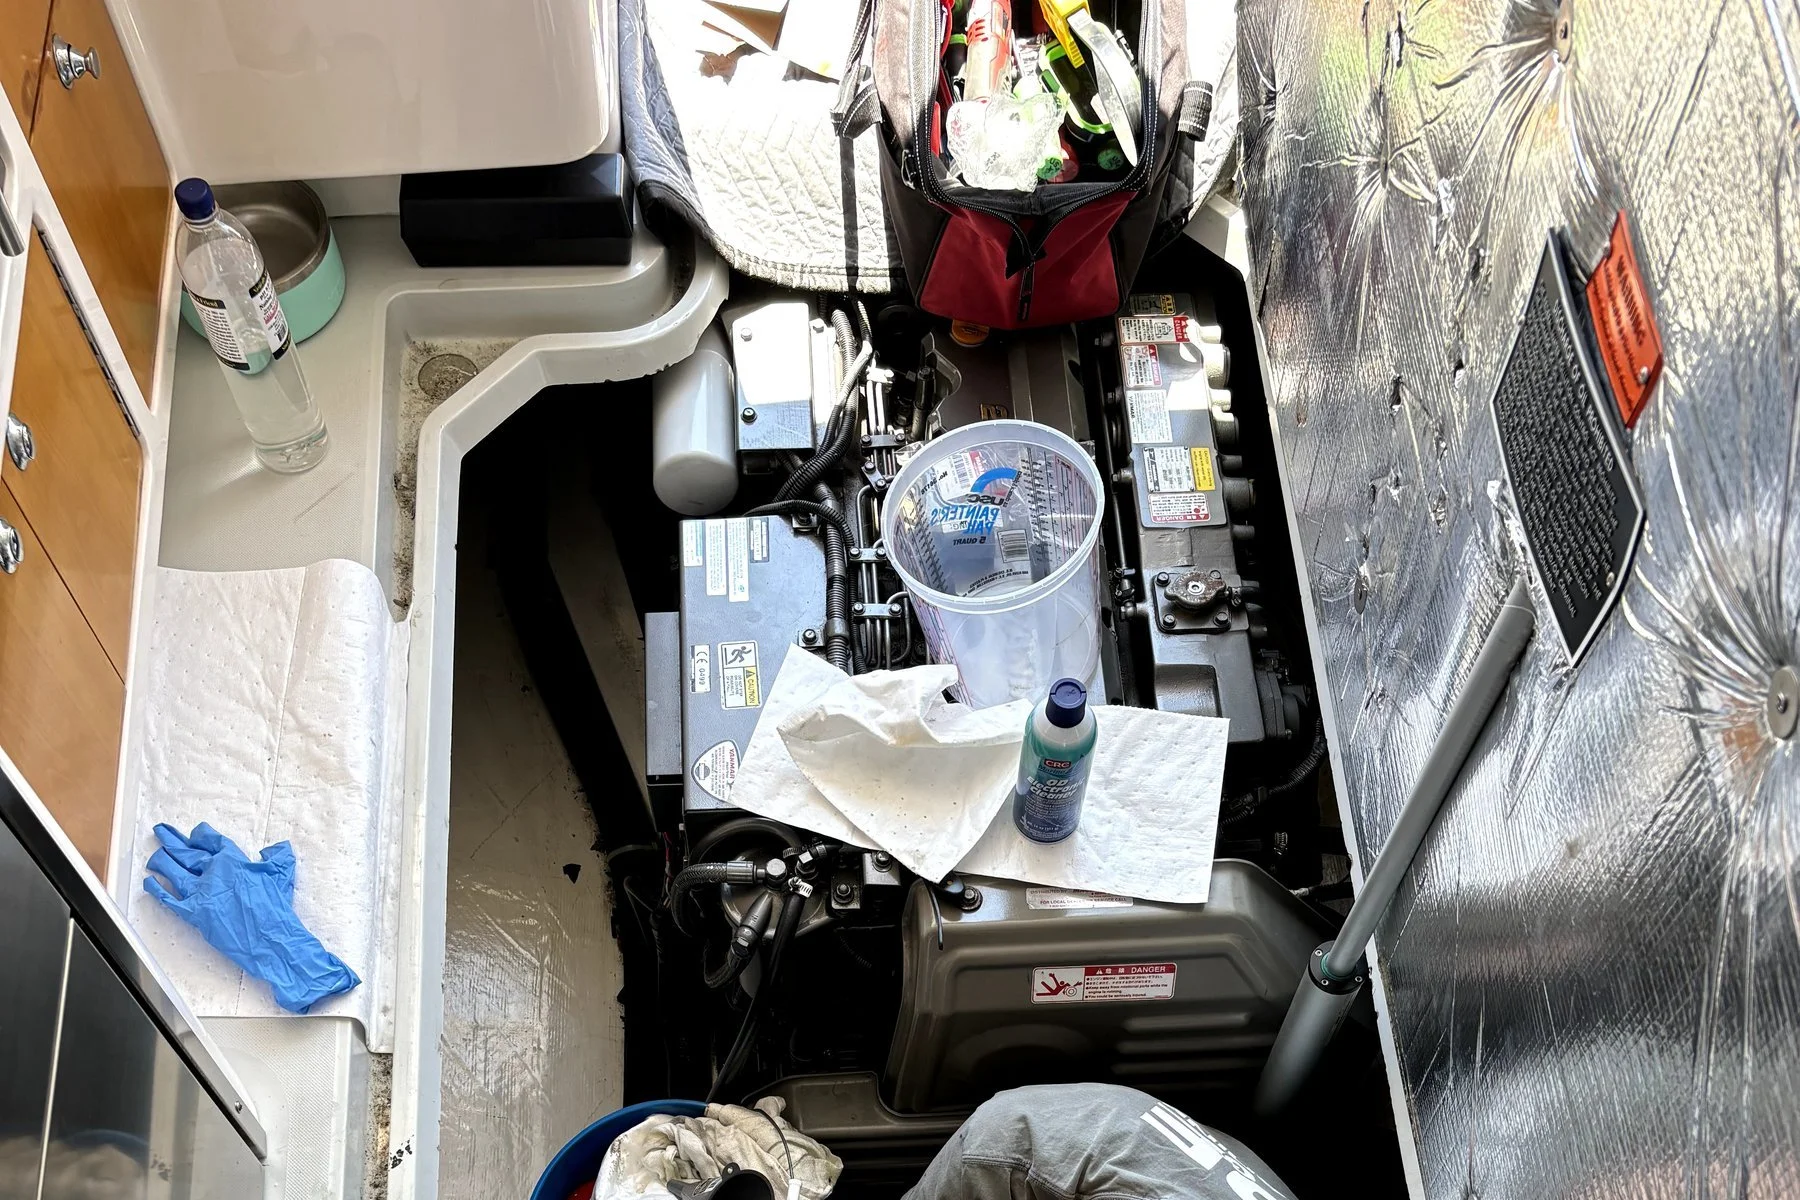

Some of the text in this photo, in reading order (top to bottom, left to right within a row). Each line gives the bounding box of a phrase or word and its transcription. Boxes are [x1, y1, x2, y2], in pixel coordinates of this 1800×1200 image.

[1552, 296, 1574, 369] DISCHARGE
[1570, 359, 1581, 388] OF
[1577, 377, 1589, 409] OIL
[1585, 402, 1614, 474] PROHIBITED
[1588, 465, 1596, 486] OR
[1608, 509, 1618, 531] THE
[1594, 520, 1614, 564] NATURAL
[1563, 564, 1573, 587] ARE
[1568, 551, 1589, 602] EMULSION
[1584, 564, 1593, 583] OF
[1592, 580, 1602, 602] THE
[1600, 553, 1610, 575] THE
[1557, 574, 1576, 620] CRIMINAL
[1045, 760, 1071, 768] CRC
[1046, 779, 1069, 787] QD
[1030, 786, 1076, 799] Cleaner
